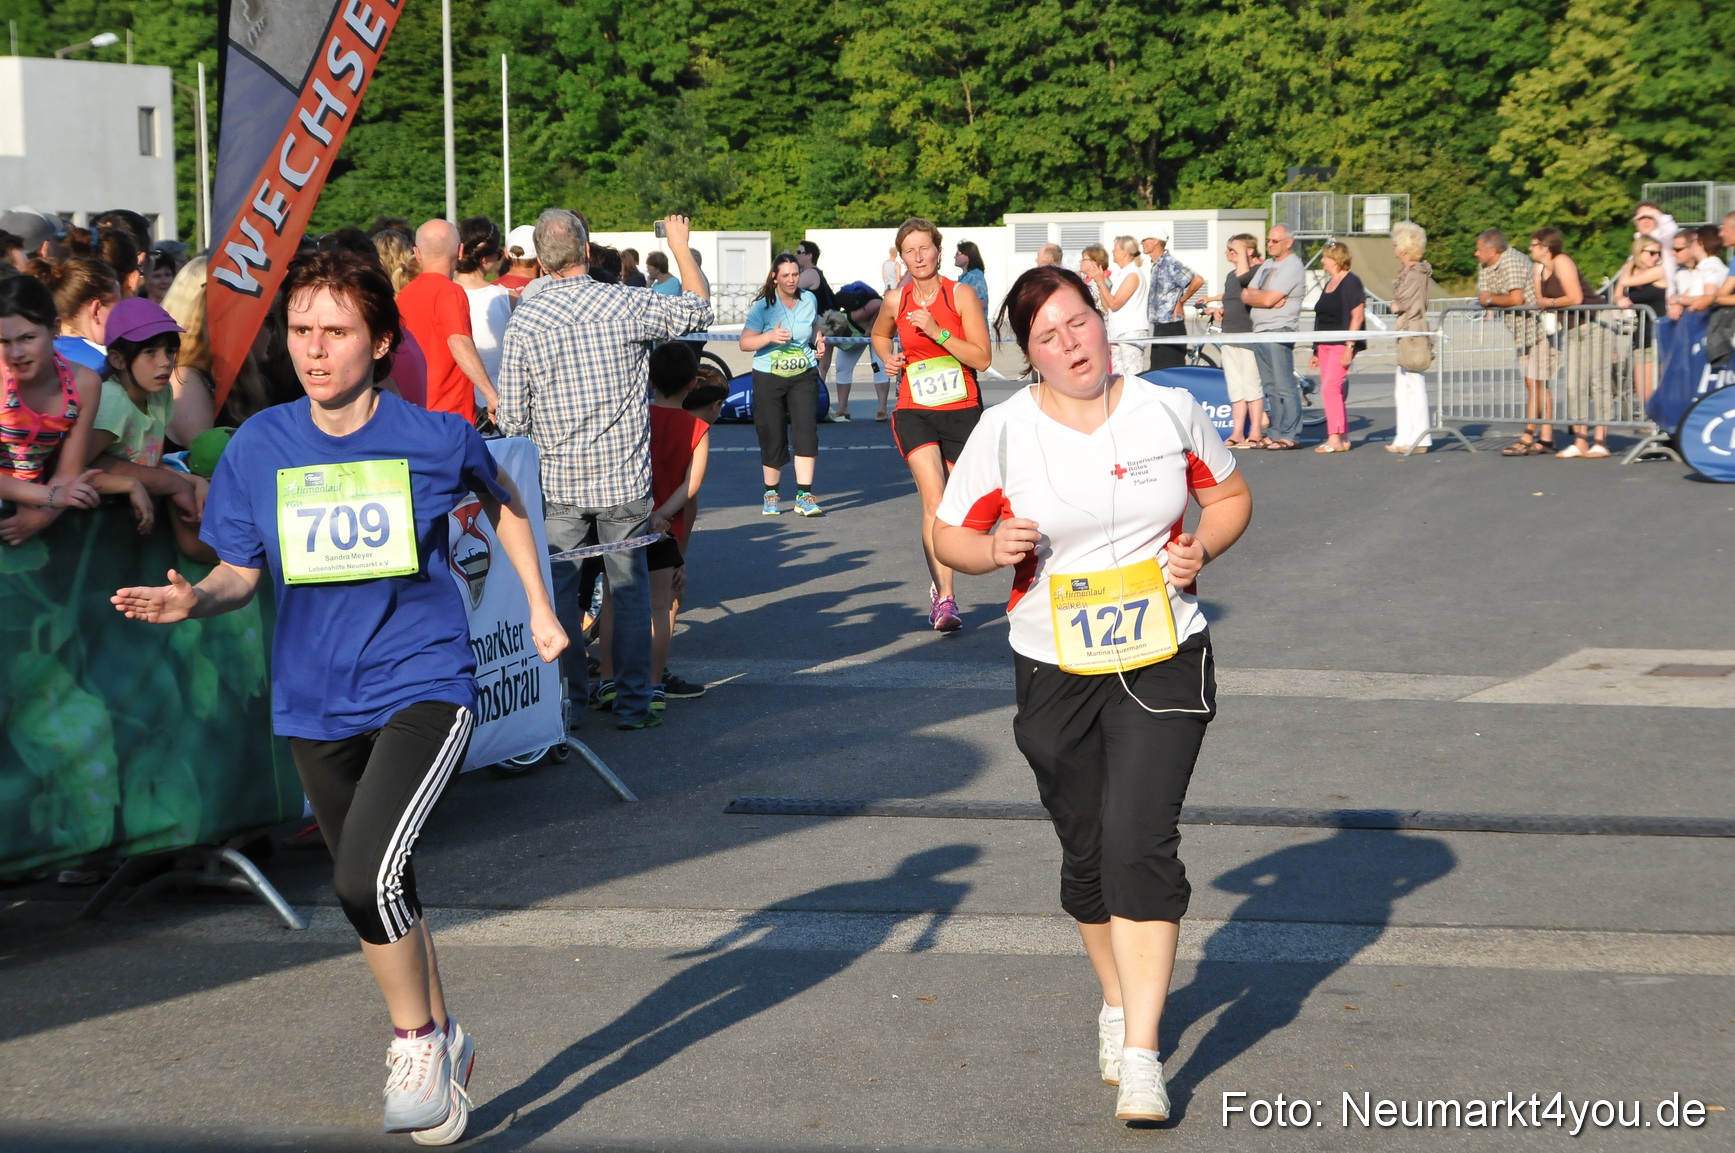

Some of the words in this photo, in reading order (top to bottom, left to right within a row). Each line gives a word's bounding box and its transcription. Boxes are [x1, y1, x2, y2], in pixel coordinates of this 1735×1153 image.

[212, 0, 398, 297] WECHSE
[774, 358, 807, 371] 1380
[912, 369, 960, 397] 1317
[1127, 455, 1164, 467] Bayerisches
[1128, 464, 1147, 472] Rotes
[296, 483, 343, 496] firmenlauf
[297, 502, 390, 553] 709
[325, 554, 350, 562] Sandra
[351, 552, 373, 561] Meyer
[308, 563, 346, 572] Lebenshilfe
[346, 561, 378, 570] Neumarkt
[1065, 587, 1106, 599] firmenlauf
[1071, 598, 1149, 649] 127
[470, 620, 525, 667] markter
[1086, 650, 1111, 658] Martina
